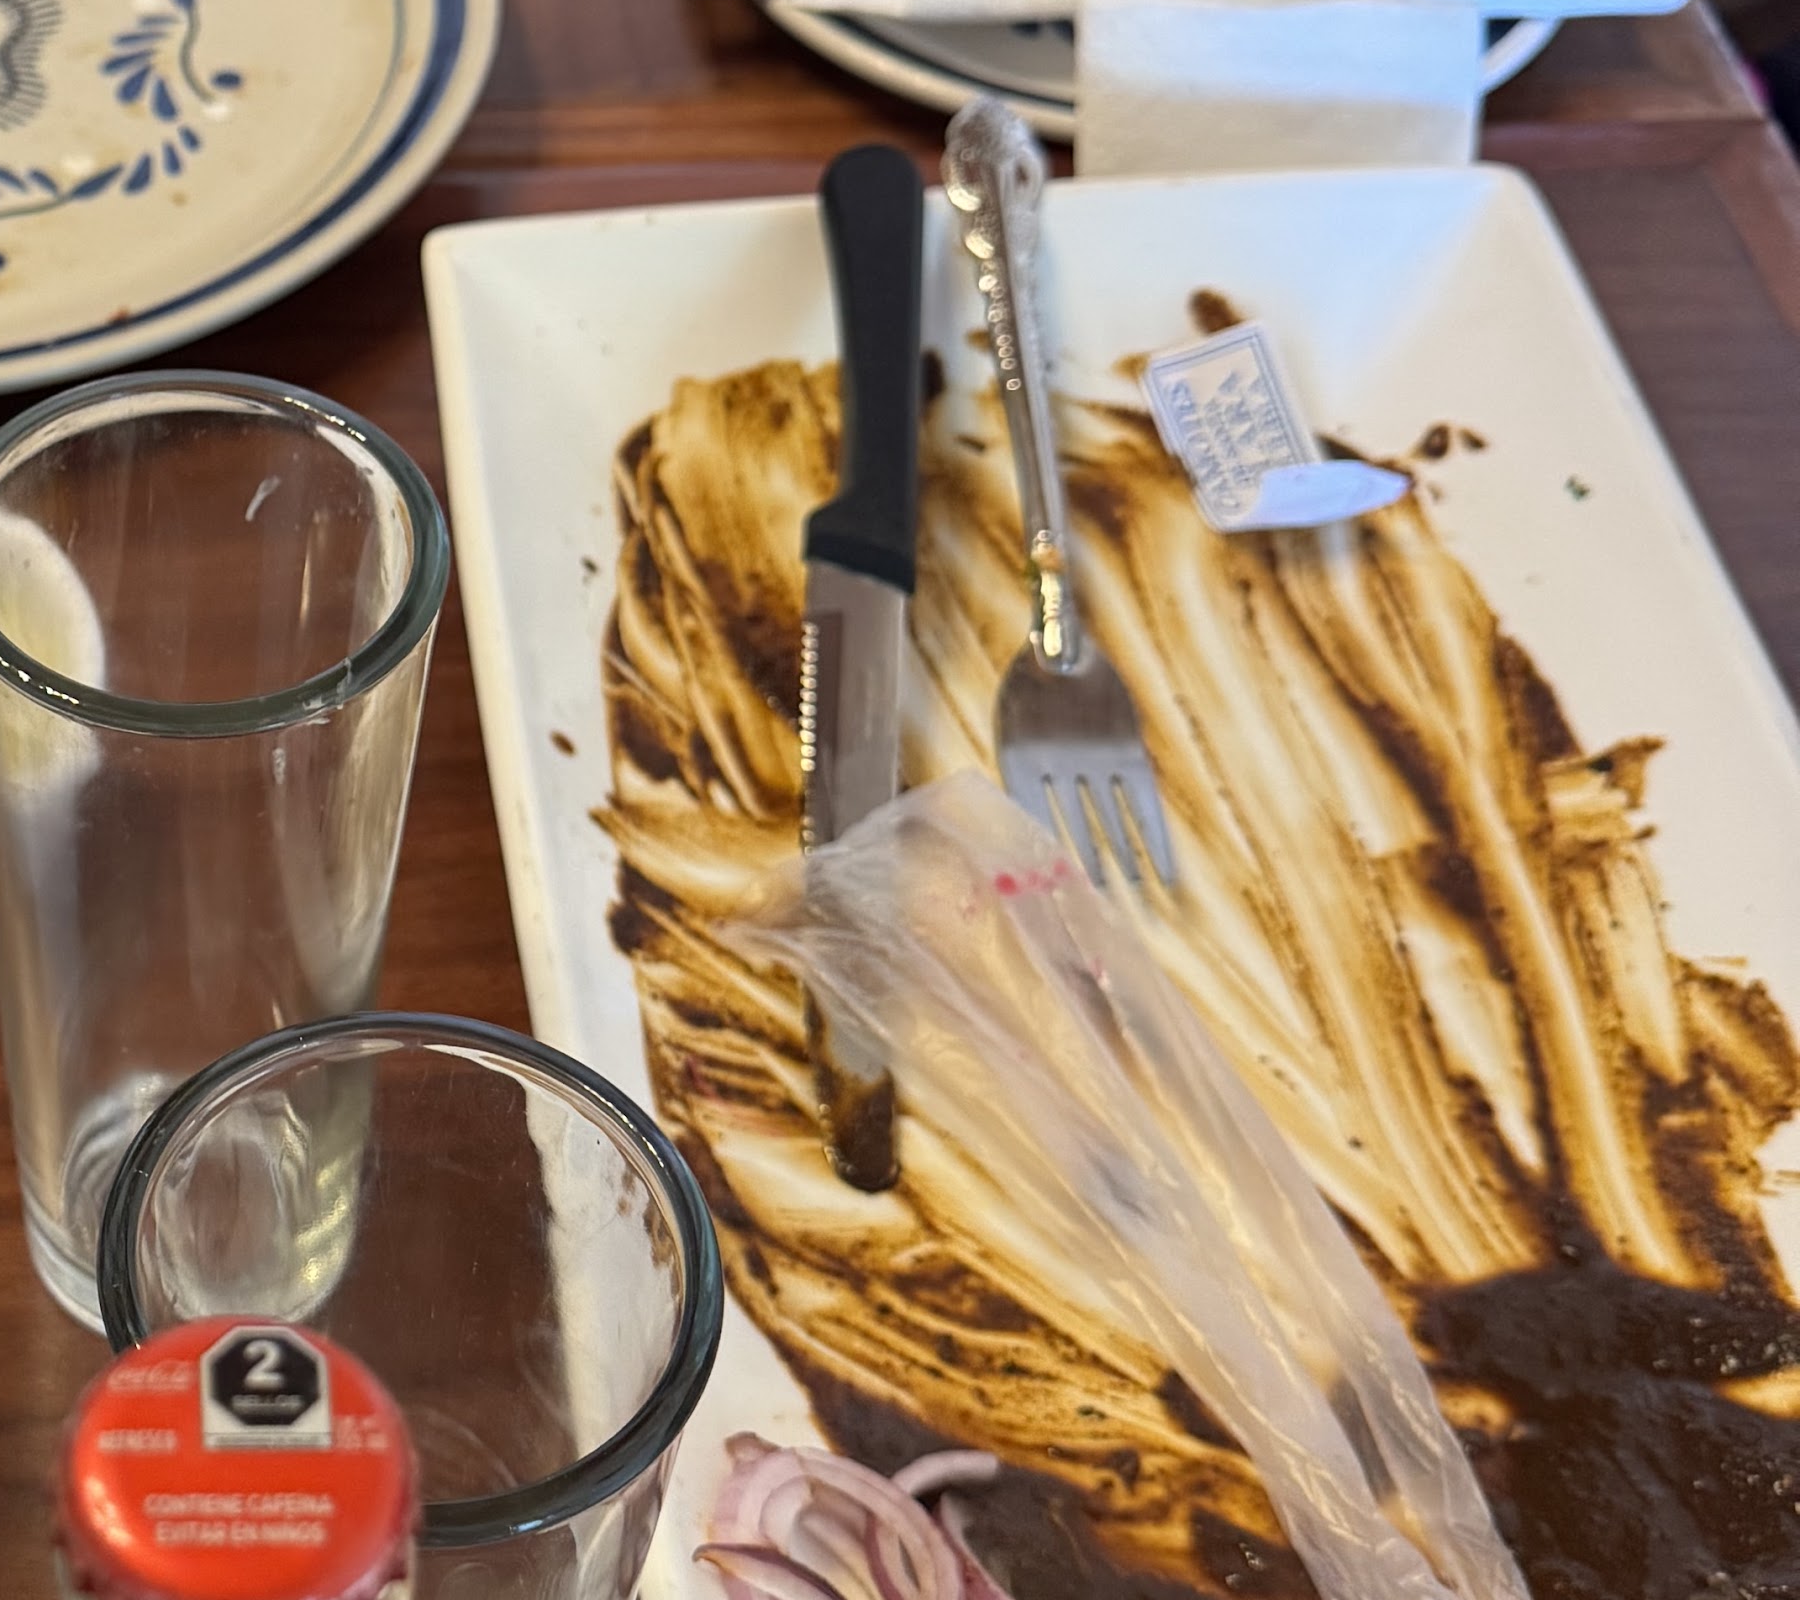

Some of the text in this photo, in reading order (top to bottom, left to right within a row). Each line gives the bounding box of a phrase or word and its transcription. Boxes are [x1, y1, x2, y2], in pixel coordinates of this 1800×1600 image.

[242, 1339, 285, 1390] 2
[144, 1493, 242, 1518] CONTIENE
[154, 1521, 226, 1546] EVITAR
[230, 1521, 257, 1546] EN
